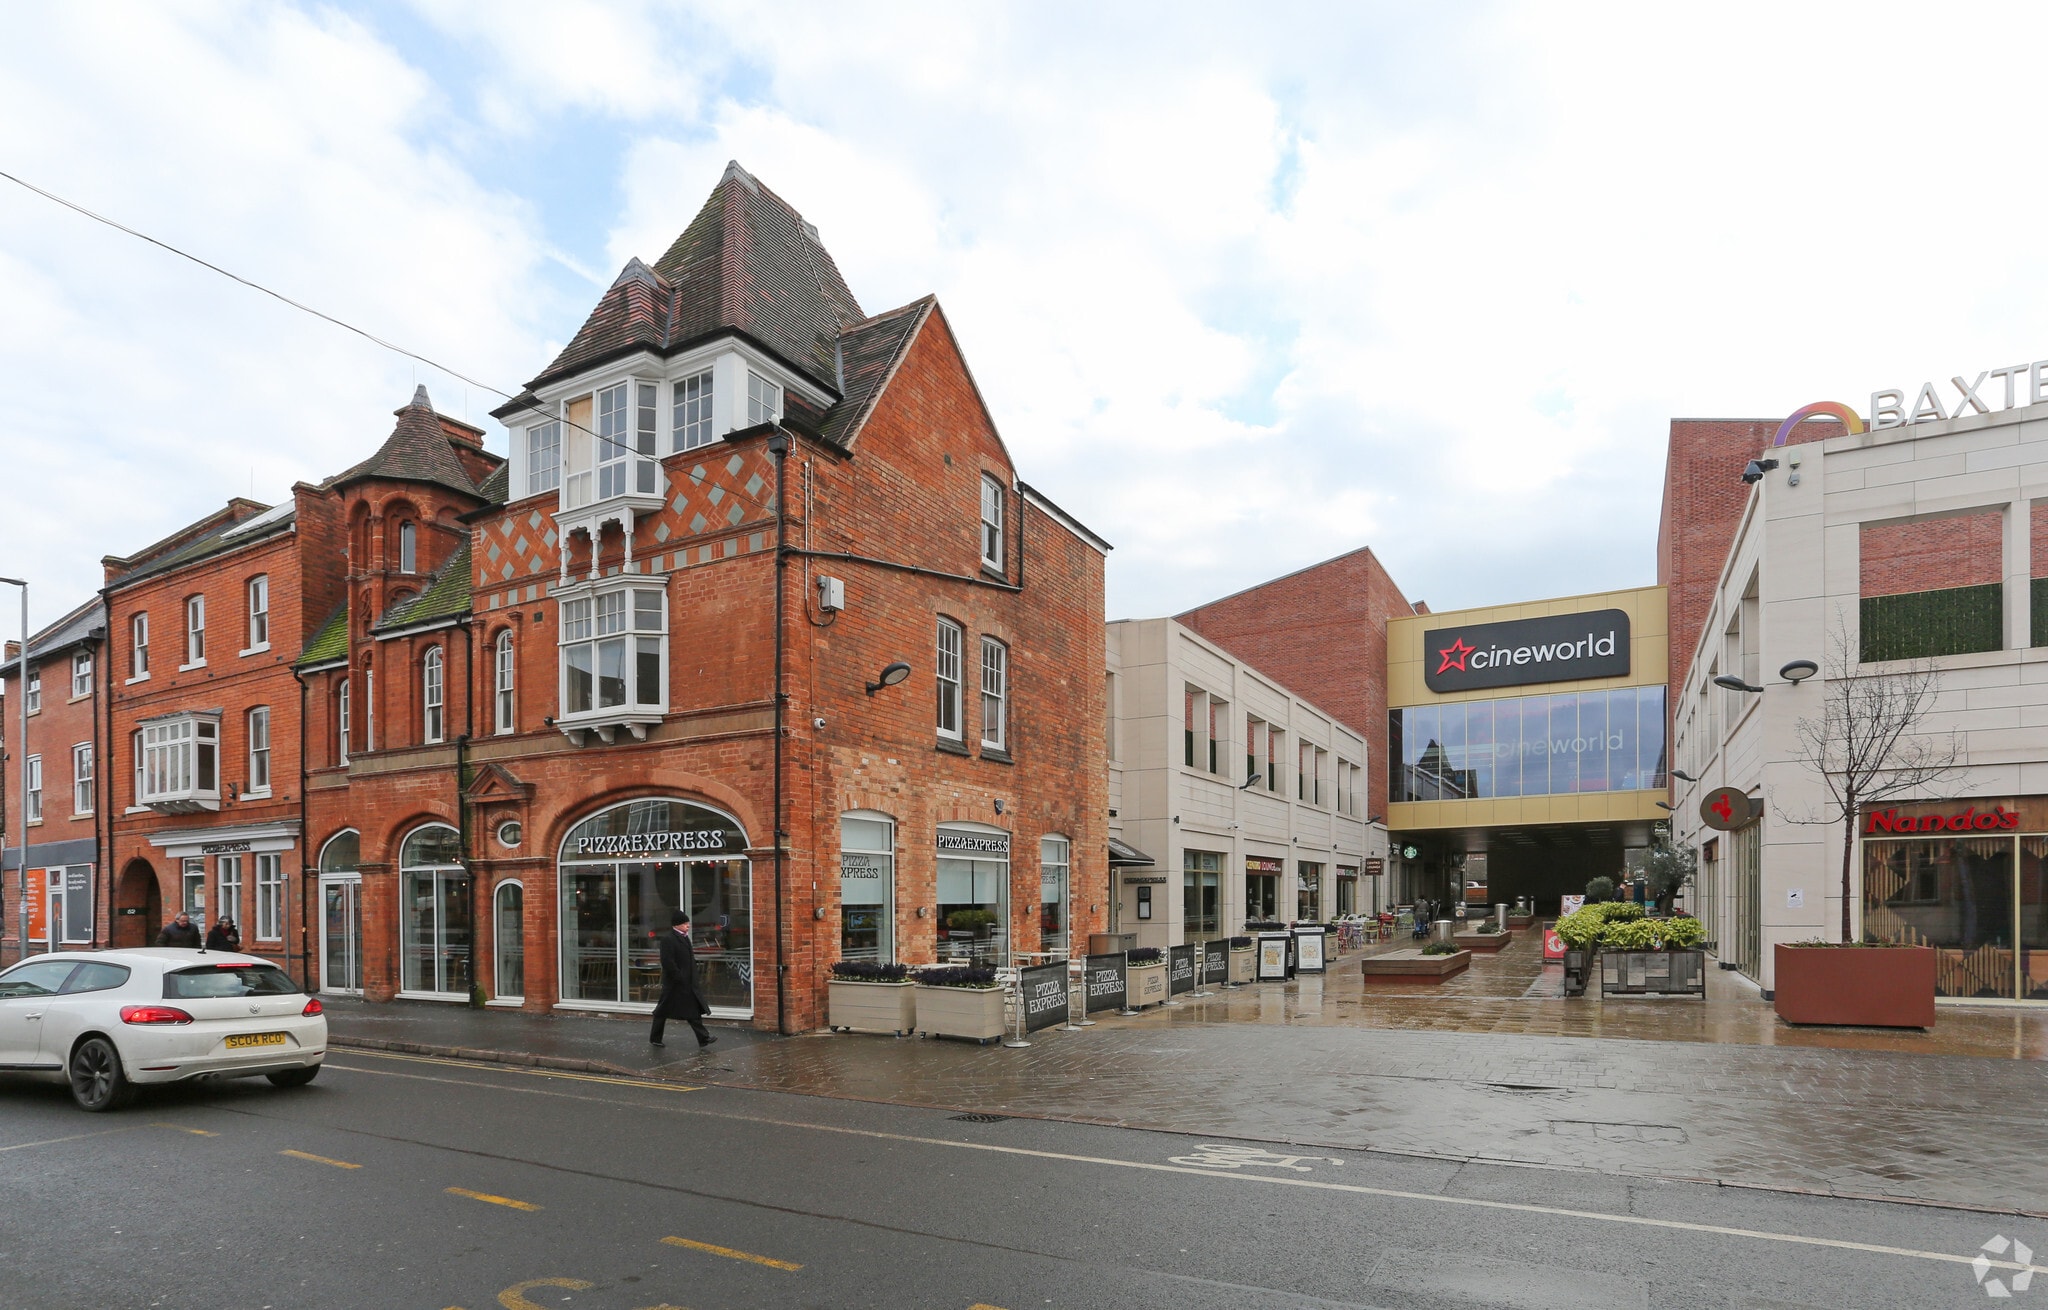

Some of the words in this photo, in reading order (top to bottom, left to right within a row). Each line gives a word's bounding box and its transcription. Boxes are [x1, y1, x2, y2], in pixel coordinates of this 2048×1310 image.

[1471, 631, 1615, 669] cineworld
[1495, 729, 1623, 758] cineworld
[1865, 806, 2020, 833] Nando's
[577, 829, 725, 854] PIZZAEXPRESS
[937, 835, 1009, 853] PIZZAEXPRESS
[842, 855, 870, 867] PIZZA
[841, 867, 878, 879] XPRESS
[1095, 969, 1119, 983] PIZZA
[1035, 980, 1061, 998] PIZZA
[1090, 980, 1125, 996] EXPRESS
[1029, 992, 1067, 1014] EXPRESS
[230, 1035, 259, 1047] SC04
[262, 1033, 282, 1044] RCO
